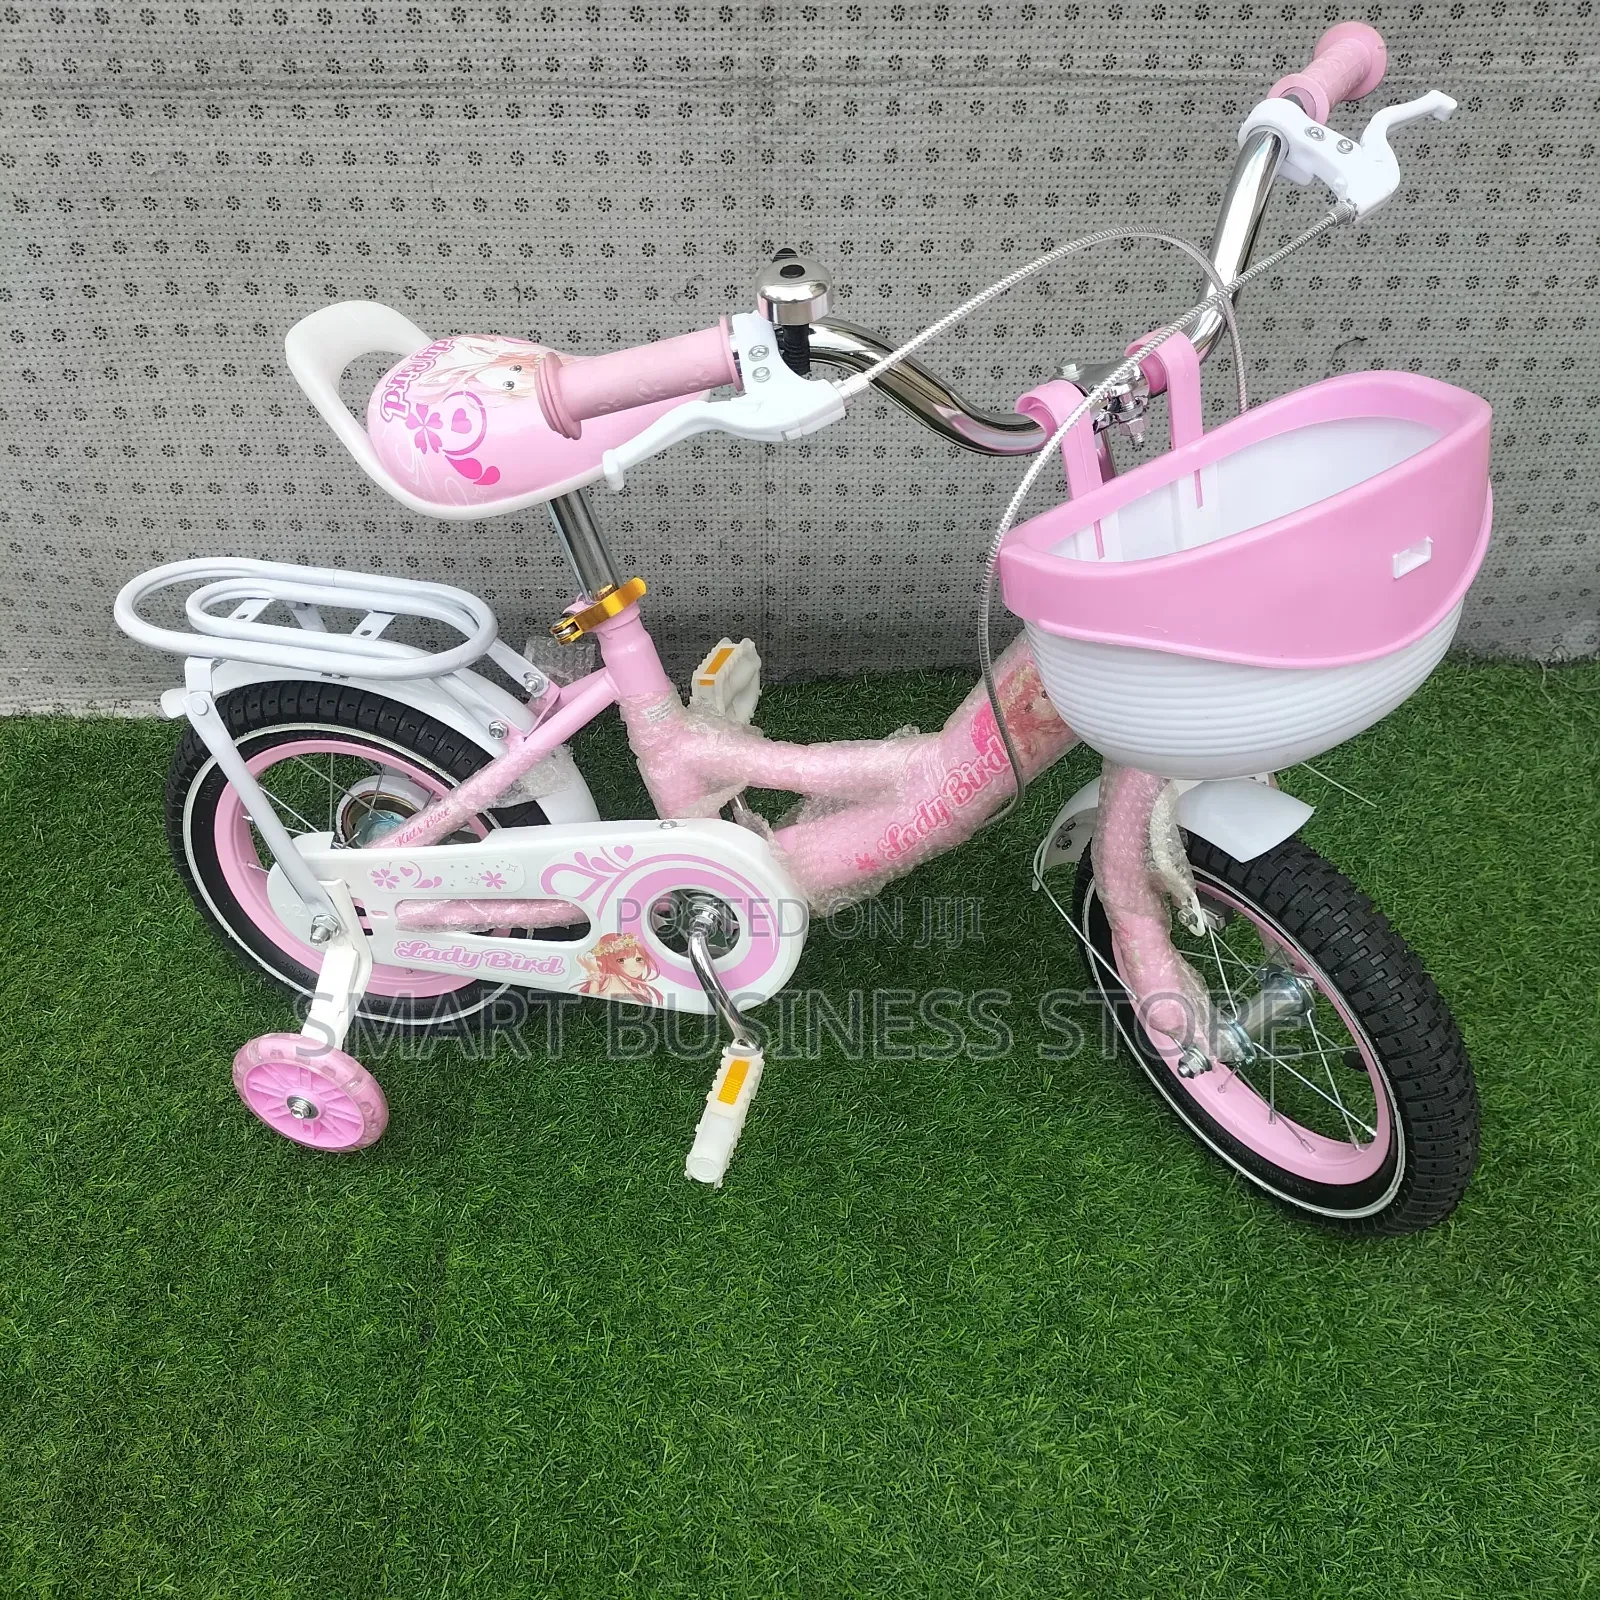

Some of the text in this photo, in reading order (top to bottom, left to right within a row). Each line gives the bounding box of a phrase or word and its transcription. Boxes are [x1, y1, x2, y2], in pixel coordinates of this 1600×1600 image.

[381, 360, 436, 423] Bird
[877, 735, 1012, 861] Lady Bird
[395, 826, 424, 847] Kids
[394, 940, 565, 976] Lady Bird
